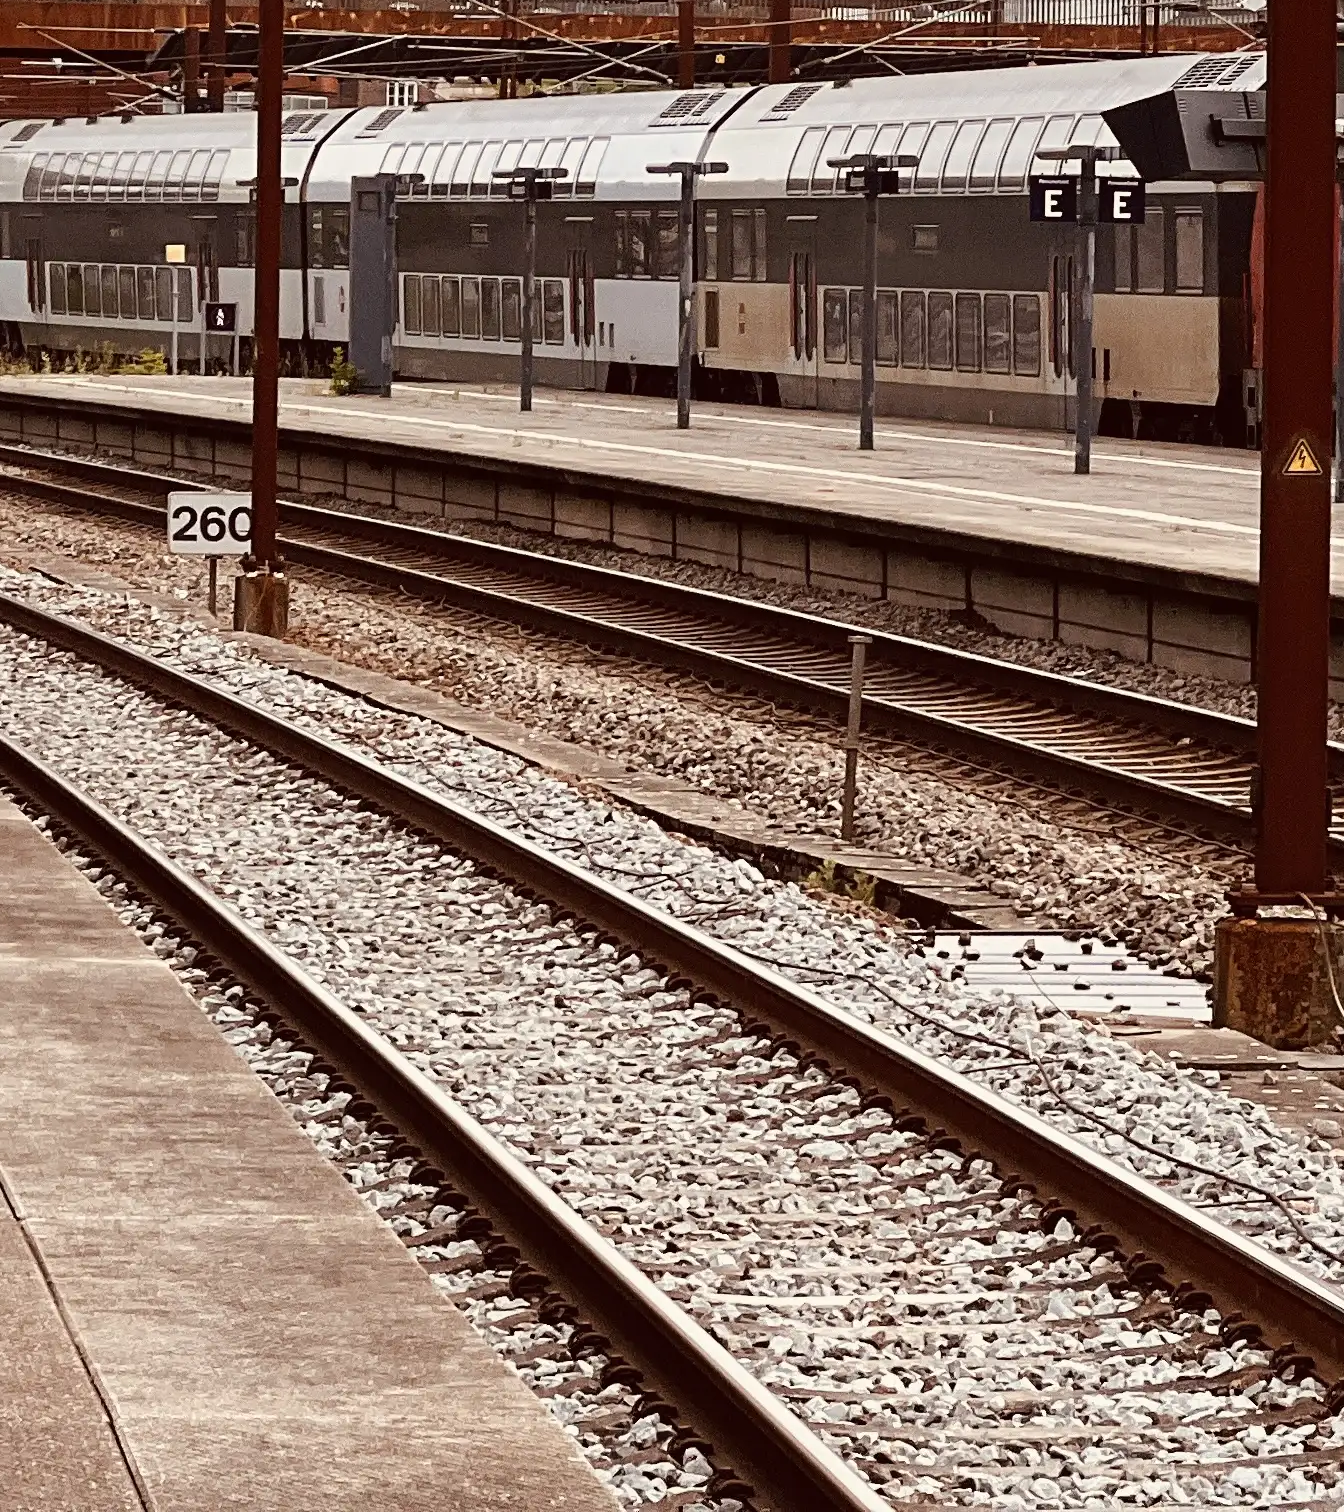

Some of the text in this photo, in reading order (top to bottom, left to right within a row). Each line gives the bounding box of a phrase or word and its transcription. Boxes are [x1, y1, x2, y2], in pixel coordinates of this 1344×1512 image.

[1044, 189, 1063, 218] E
[1113, 191, 1132, 219] E
[172, 505, 253, 542] 260
